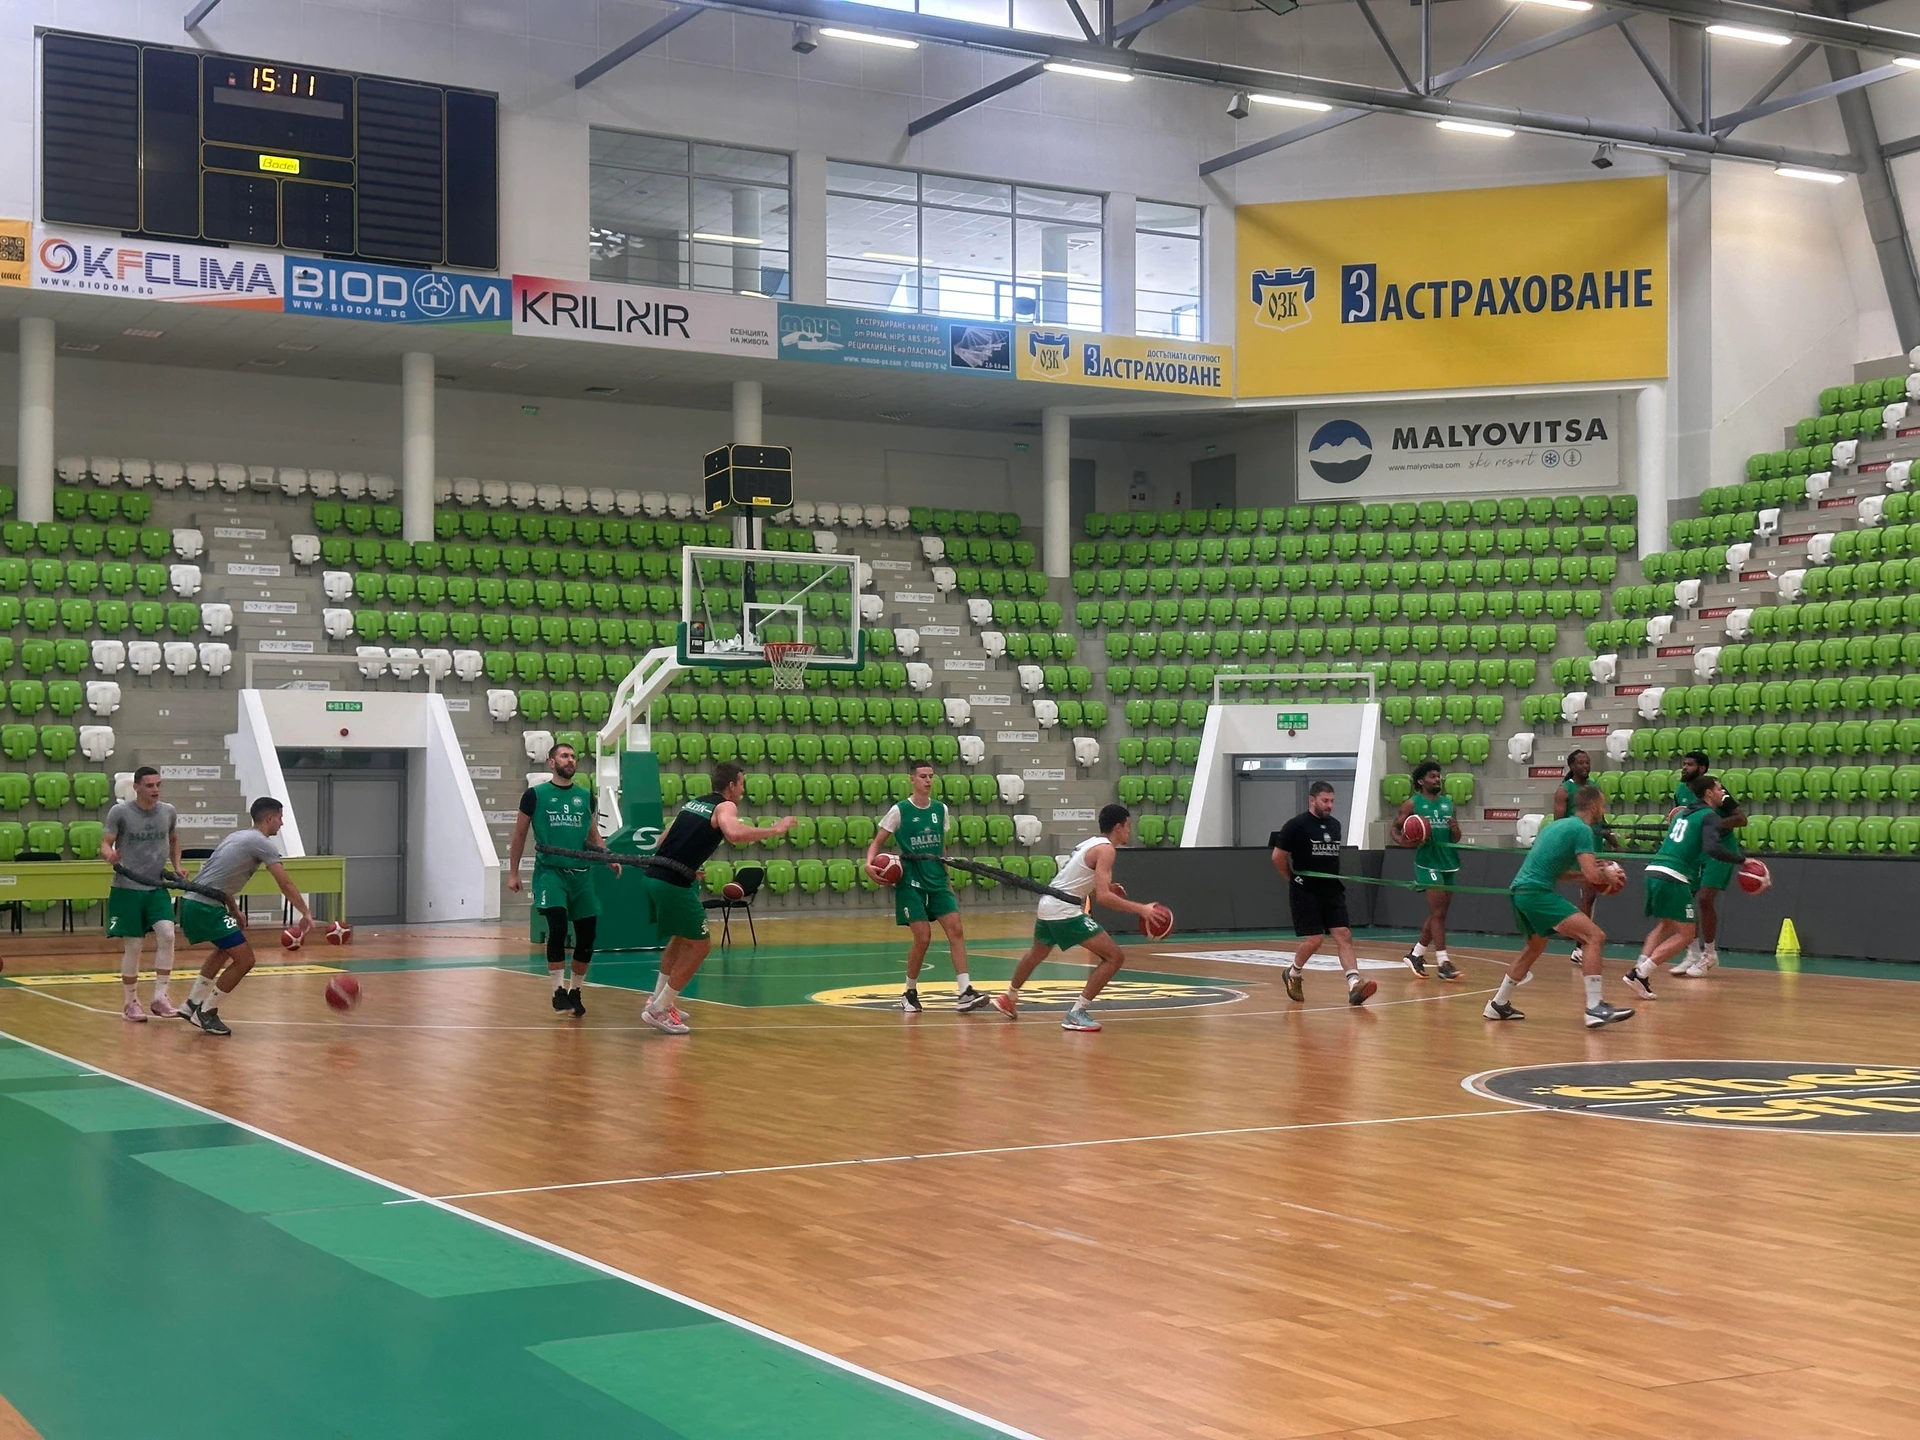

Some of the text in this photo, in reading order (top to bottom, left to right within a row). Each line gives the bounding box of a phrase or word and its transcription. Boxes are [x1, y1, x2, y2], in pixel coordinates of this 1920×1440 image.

[252, 67, 316, 97] 15:11
[40, 276, 154, 295] WWW.BIODOM.BG
[1343, 265, 1653, 323] ЗАСТРАХОВАНЕ
[292, 300, 407, 318] WWW.BIODOM.BG
[522, 289, 691, 339] KRILIXIR
[730, 327, 769, 338] ЕСЕНЦИЯТА
[856, 317, 906, 329] ЕКСТРУДИРАНЕ
[916, 324, 939, 332] ЛИСТИ
[740, 338, 769, 346] ЖИВОТА
[848, 341, 897, 353] РЕЦИКЛИРАНЕ
[907, 347, 947, 357] ПЛАСТМАСИ
[1147, 349, 1221, 363] ДОСТЪПНАТА СИГУРНОСТ
[1084, 345, 1222, 387] ЗАСТРАХОВАНЕ
[1392, 418, 1608, 450] MALYOVITSA
[1388, 461, 1461, 472] www.malyovitsa.com
[1468, 450, 1538, 469] ski resort
[563, 804, 569, 814] 9
[109, 921, 117, 930] 7
